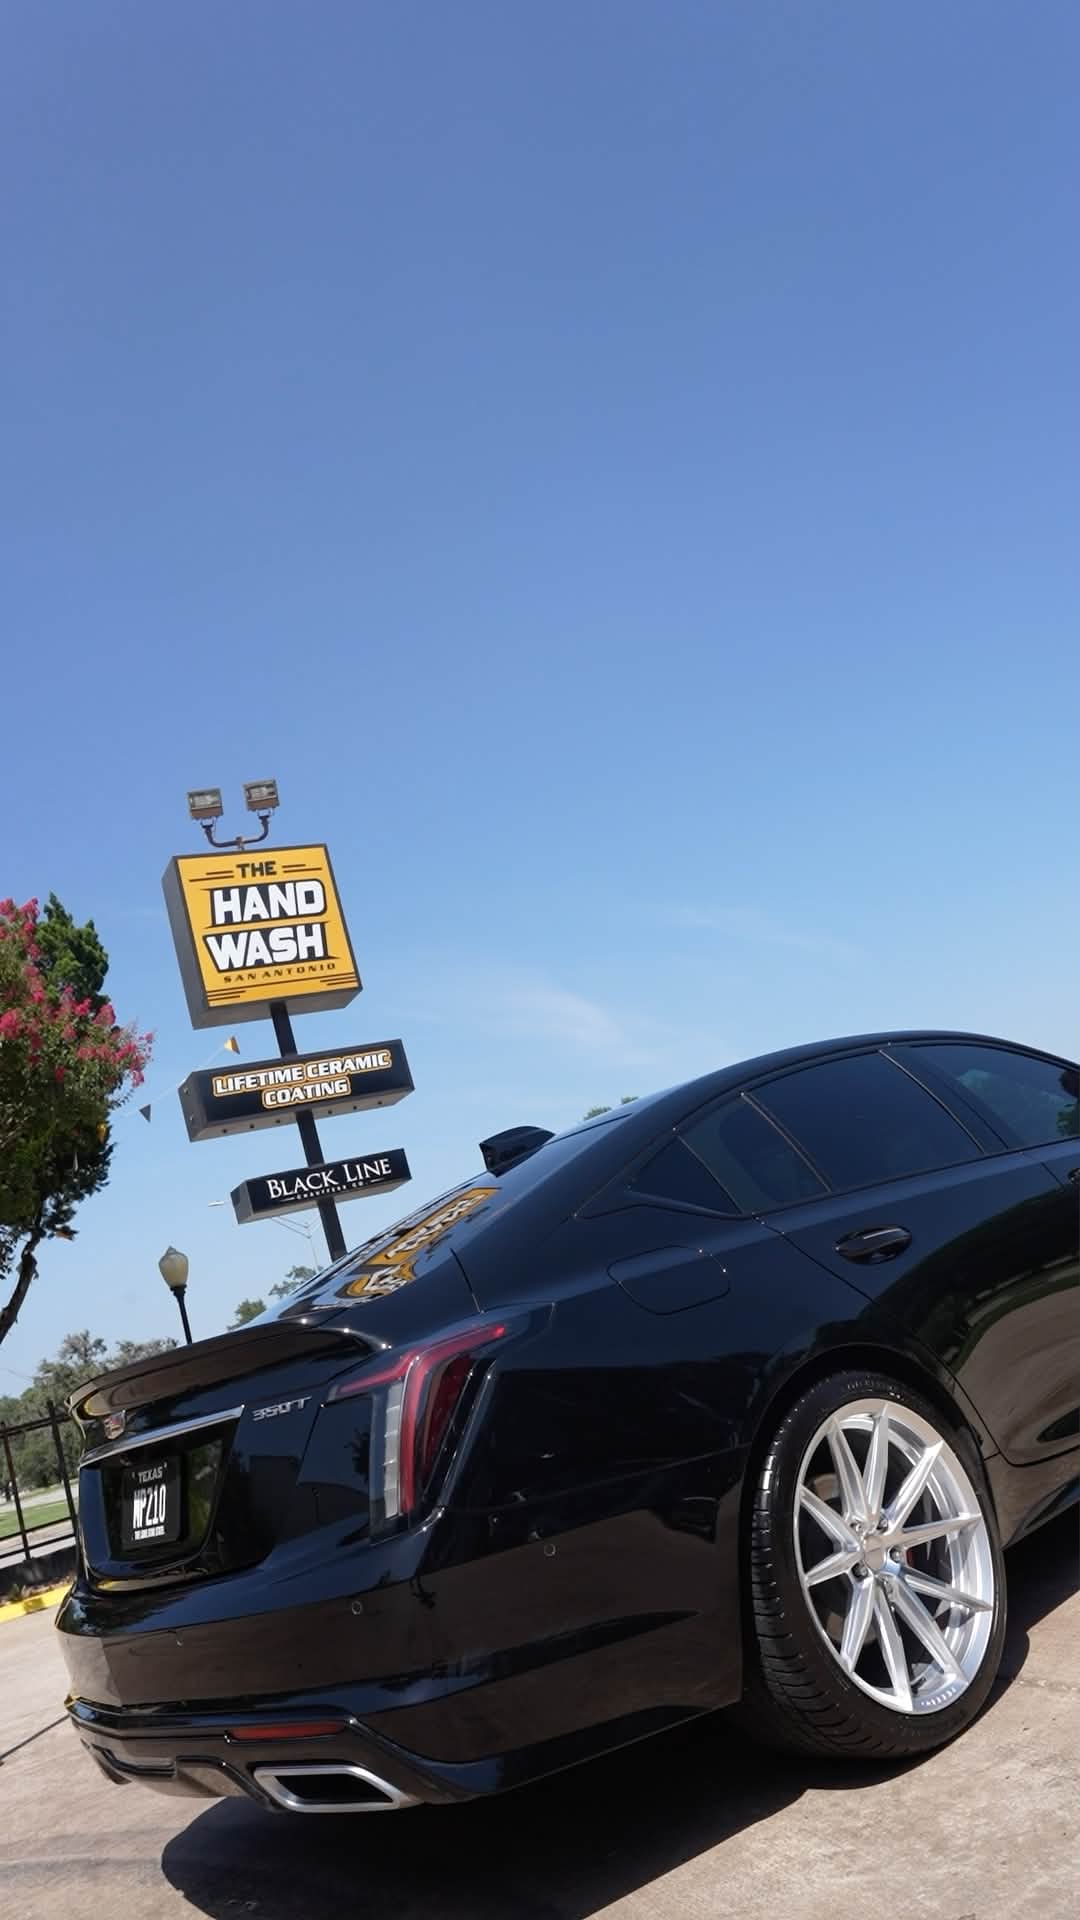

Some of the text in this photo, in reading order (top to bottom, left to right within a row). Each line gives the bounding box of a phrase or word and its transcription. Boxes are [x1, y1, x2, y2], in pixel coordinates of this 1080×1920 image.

[236, 860, 277, 879] THE
[212, 879, 326, 926] HAND
[205, 923, 326, 972] WASH
[223, 962, 336, 984] SAN ANTONIO
[213, 1051, 392, 1094] LIFETIME CERAMIC
[264, 1078, 349, 1107] COATING
[266, 1158, 392, 1199] BLACK LINE
[252, 1395, 313, 1421] 350T
[137, 1466, 163, 1484] TEXAS
